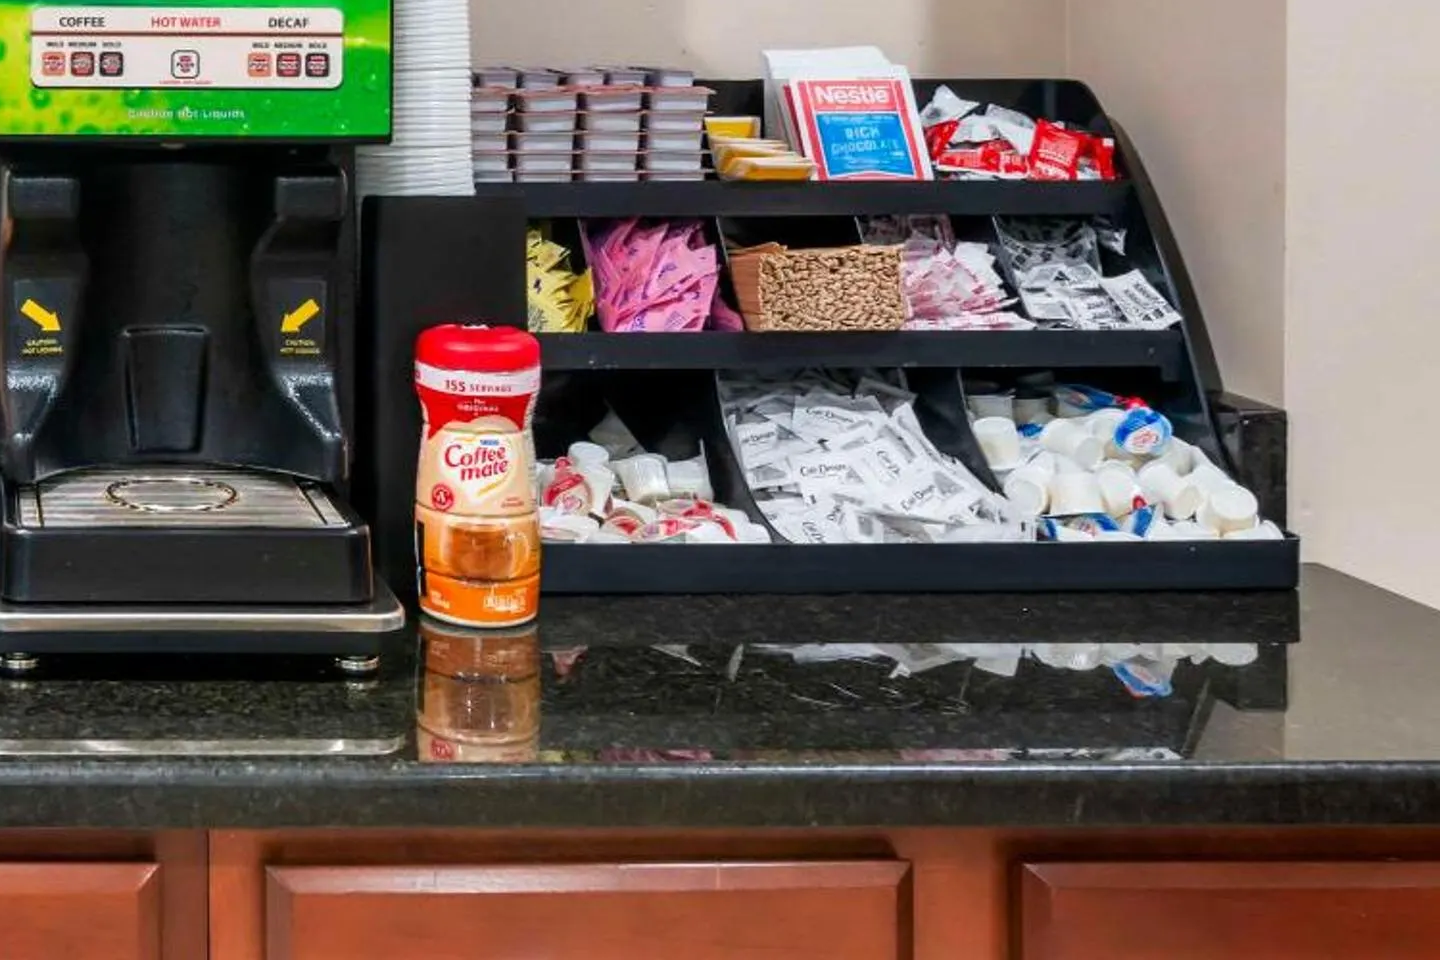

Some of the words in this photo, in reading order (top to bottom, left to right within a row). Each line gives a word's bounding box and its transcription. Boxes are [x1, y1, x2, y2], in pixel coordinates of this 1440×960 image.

[59, 16, 105, 28] COFFEE
[151, 16, 177, 28] HOT
[180, 16, 221, 28] WATER
[268, 16, 309, 29] DECAF
[178, 107, 198, 119] Hot
[445, 380, 466, 392] 155
[444, 444, 506, 468] Coffee
[460, 460, 508, 481] mate
